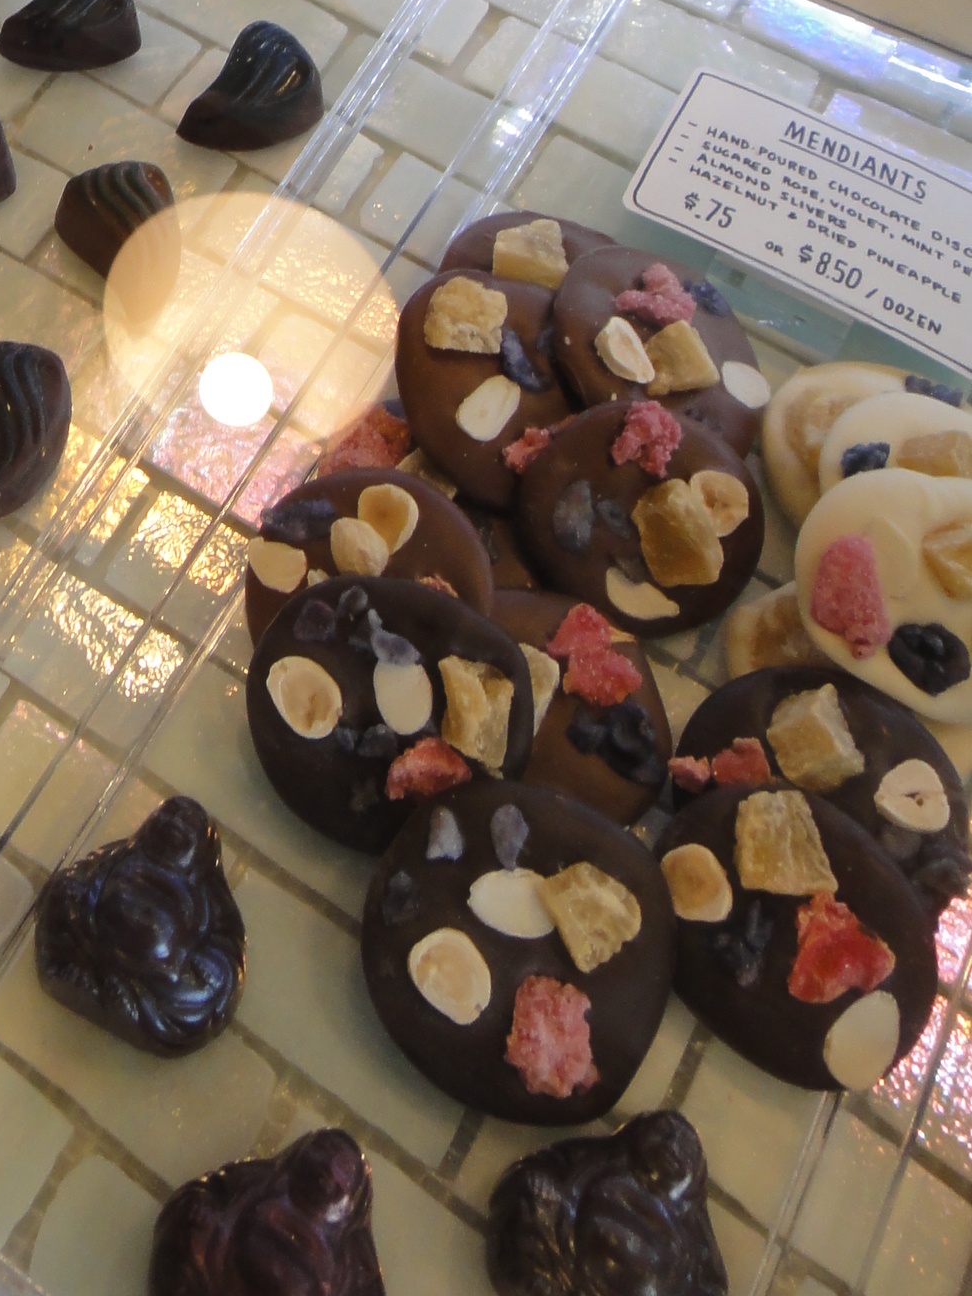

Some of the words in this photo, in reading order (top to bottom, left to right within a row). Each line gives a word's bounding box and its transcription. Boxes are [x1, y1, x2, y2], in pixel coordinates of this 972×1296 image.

[696, 152, 771, 192] ALMOND
[780, 190, 848, 230] SLIVERS
[701, 140, 772, 176] SUGARED
[901, 233, 945, 261] MINT
[783, 120, 928, 200] MENDIANTS
[689, 164, 778, 212] HAZELNUT
[806, 218, 857, 249] DRIED
[866, 247, 963, 304] PINEAPPLE
[828, 179, 921, 232] CHOCOLATE
[764, 240, 785, 257] OR
[798, 243, 863, 290] $8.50
[882, 296, 943, 336] DOZEN
